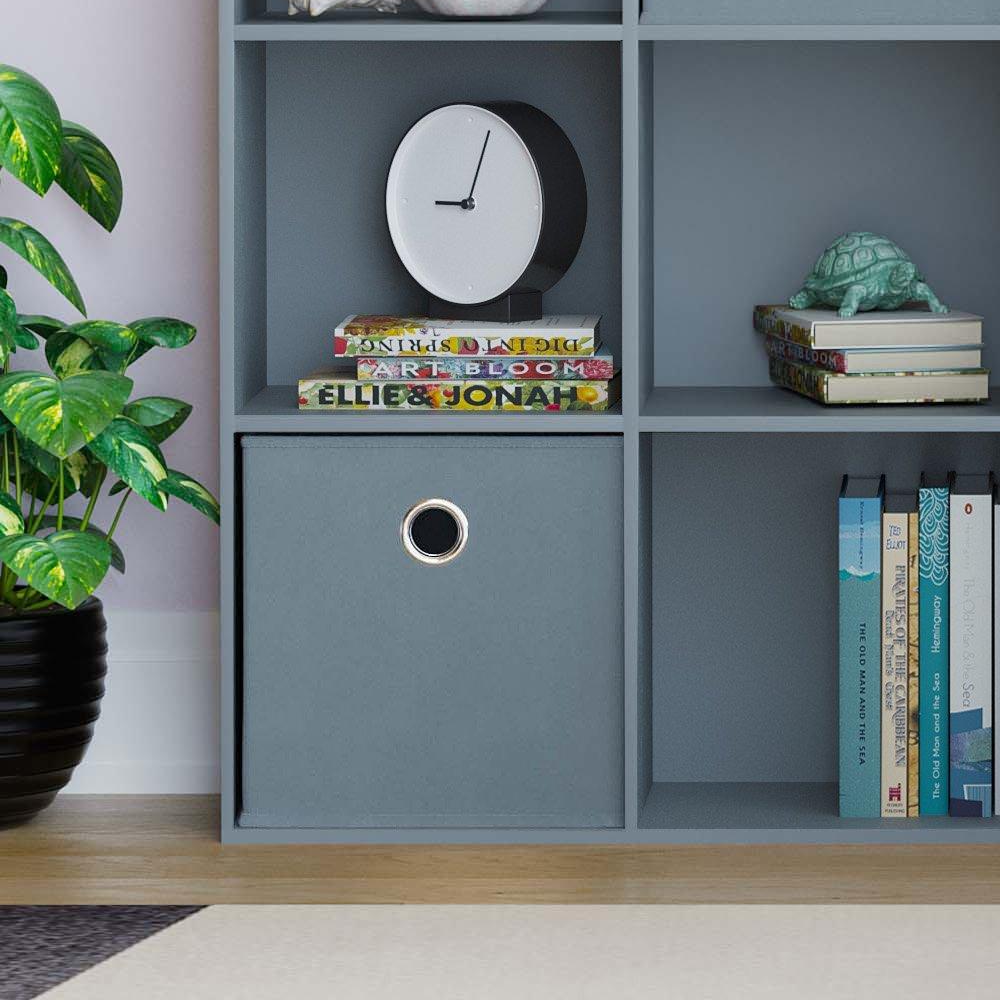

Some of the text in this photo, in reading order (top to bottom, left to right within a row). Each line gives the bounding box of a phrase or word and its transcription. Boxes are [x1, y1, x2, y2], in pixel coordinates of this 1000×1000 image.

[360, 338, 579, 354] DIG INTO SPRING
[798, 346, 838, 370] BLOOM
[374, 361, 586, 377] ART BLOOM
[317, 384, 578, 407] ELLIE & JONAH
[931, 595, 942, 653] Hemingway
[892, 564, 907, 768] PIRATES OF THE CARIBBEAN
[859, 622, 867, 766] THE OLD MAN AND THE SEA
[962, 682, 975, 708] Sea
[932, 672, 940, 800] The Old Man and the Sea
